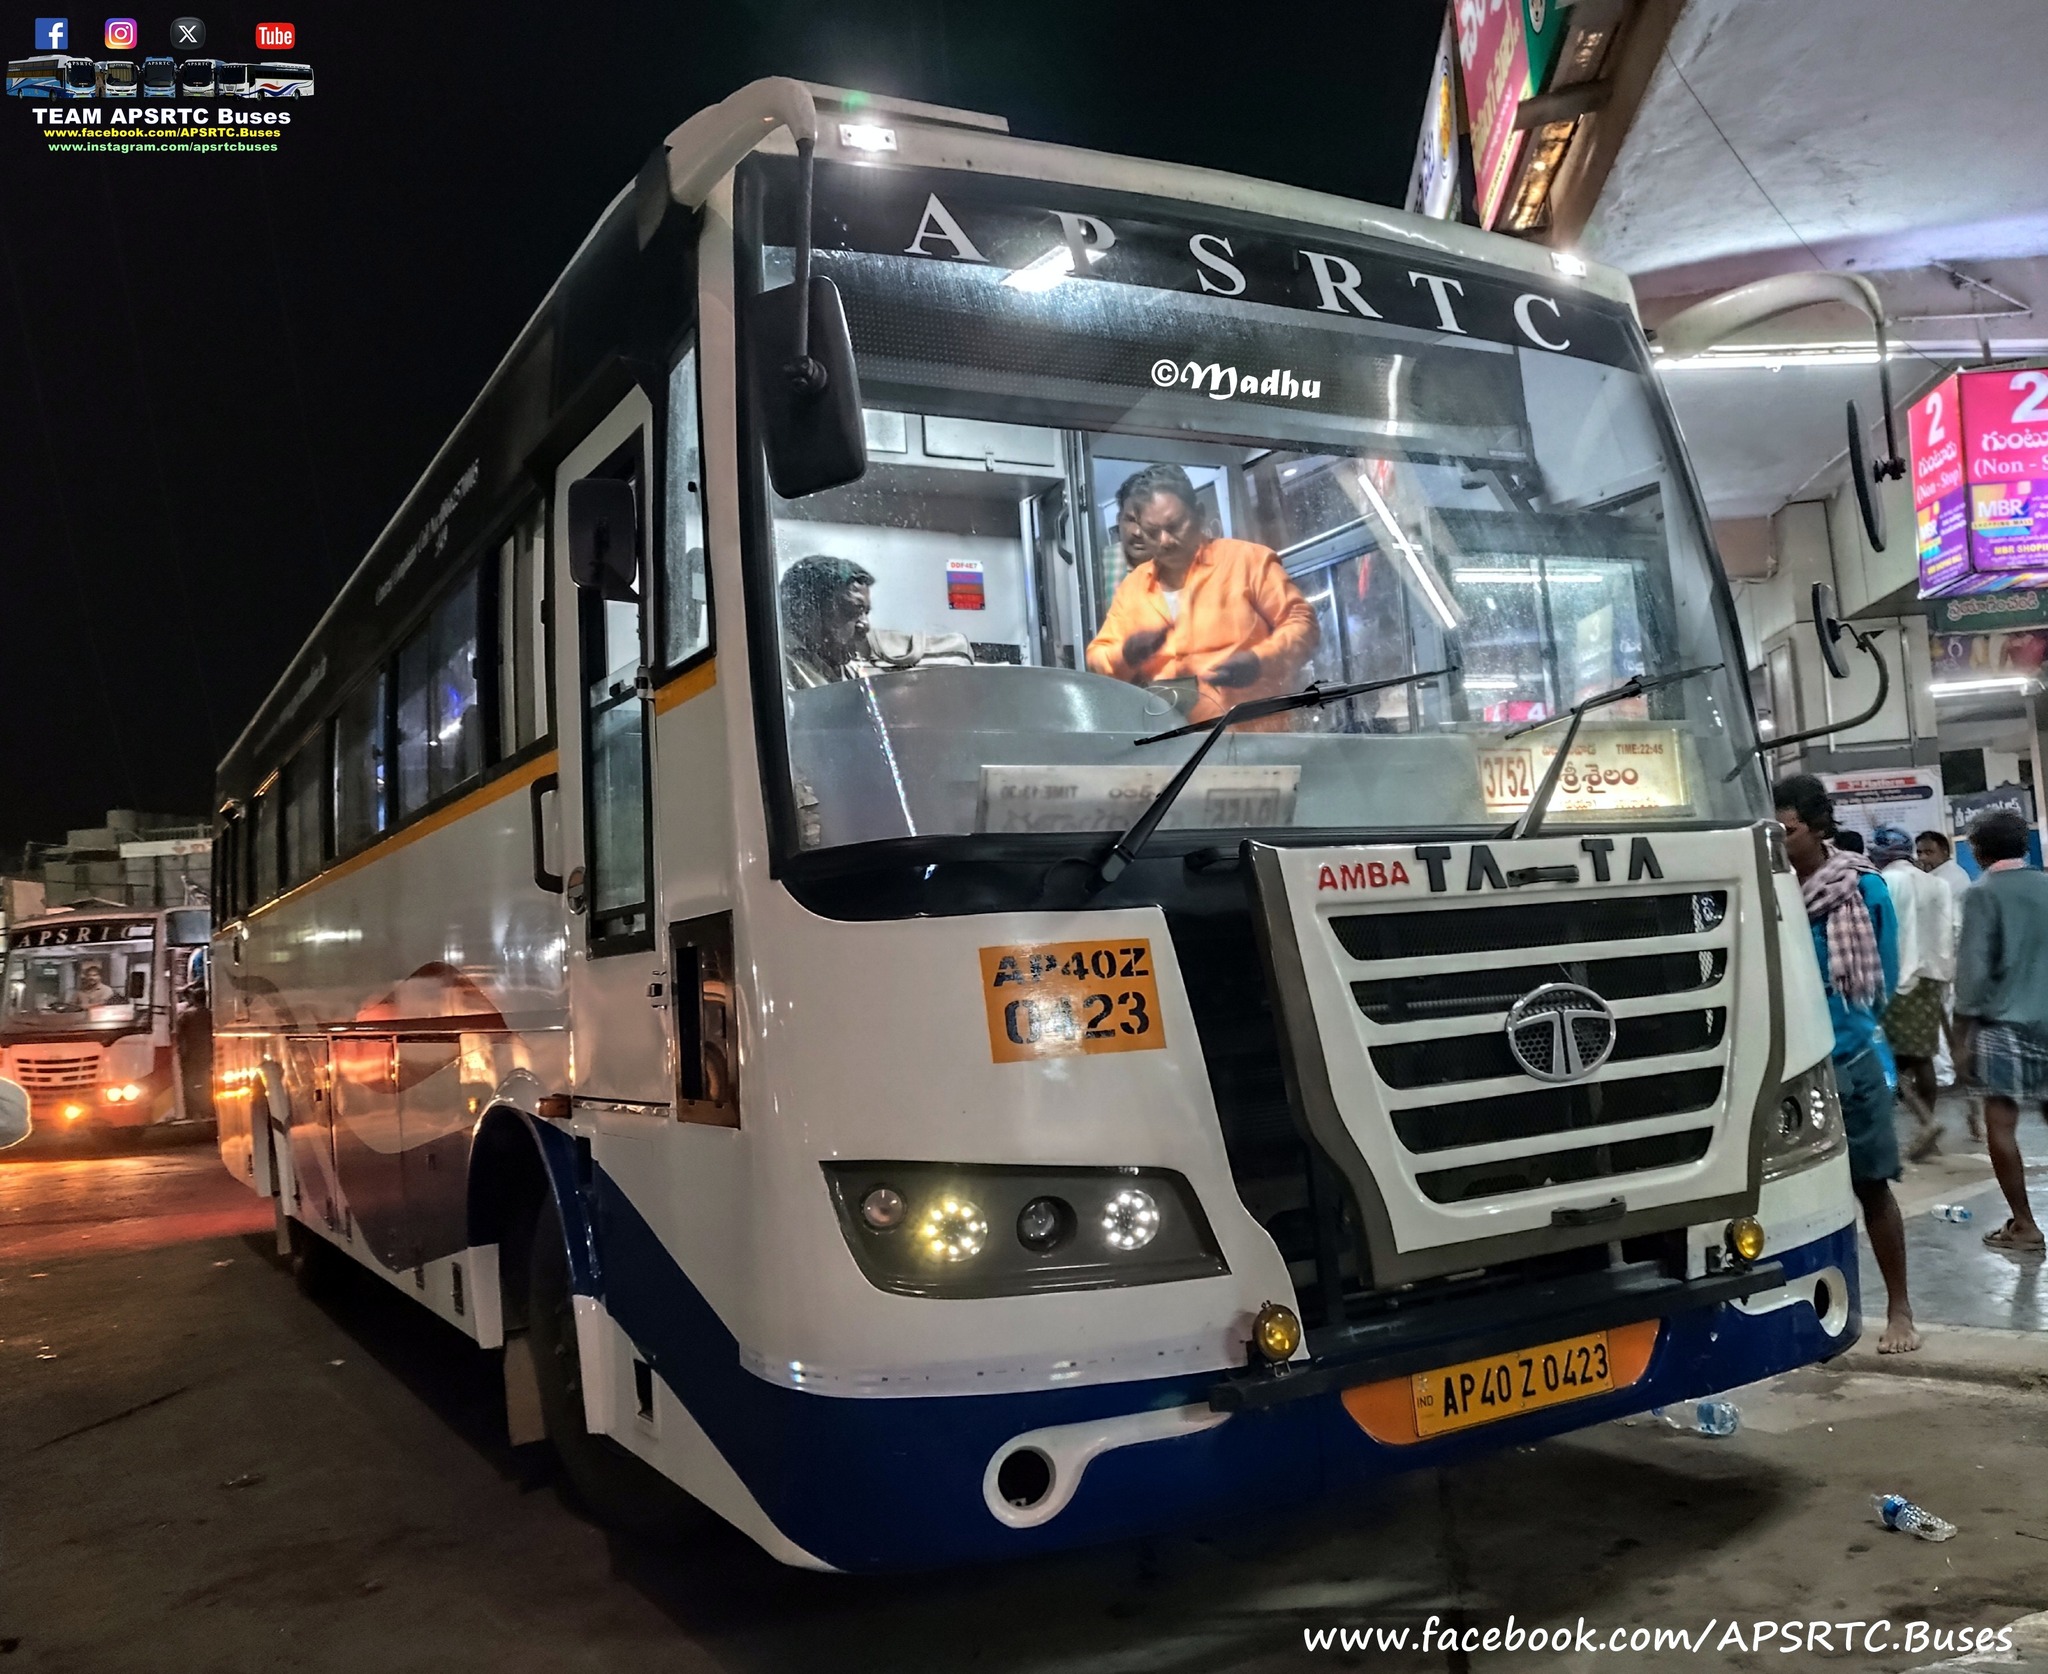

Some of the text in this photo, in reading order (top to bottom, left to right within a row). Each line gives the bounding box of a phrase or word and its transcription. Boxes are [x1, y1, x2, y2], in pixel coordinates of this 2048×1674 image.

[2009, 371, 2048, 424] 2
[1925, 391, 1945, 447] 2
[1974, 458, 2024, 479] (Non
[1977, 498, 2025, 518] MBR
[1484, 755, 1530, 798] 3752
[1318, 861, 1411, 891] AMBA
[993, 947, 1149, 988] AP40Z
[1443, 1343, 1608, 1417] AP40 Z 0423
[1416, 1396, 1434, 1408] IND
